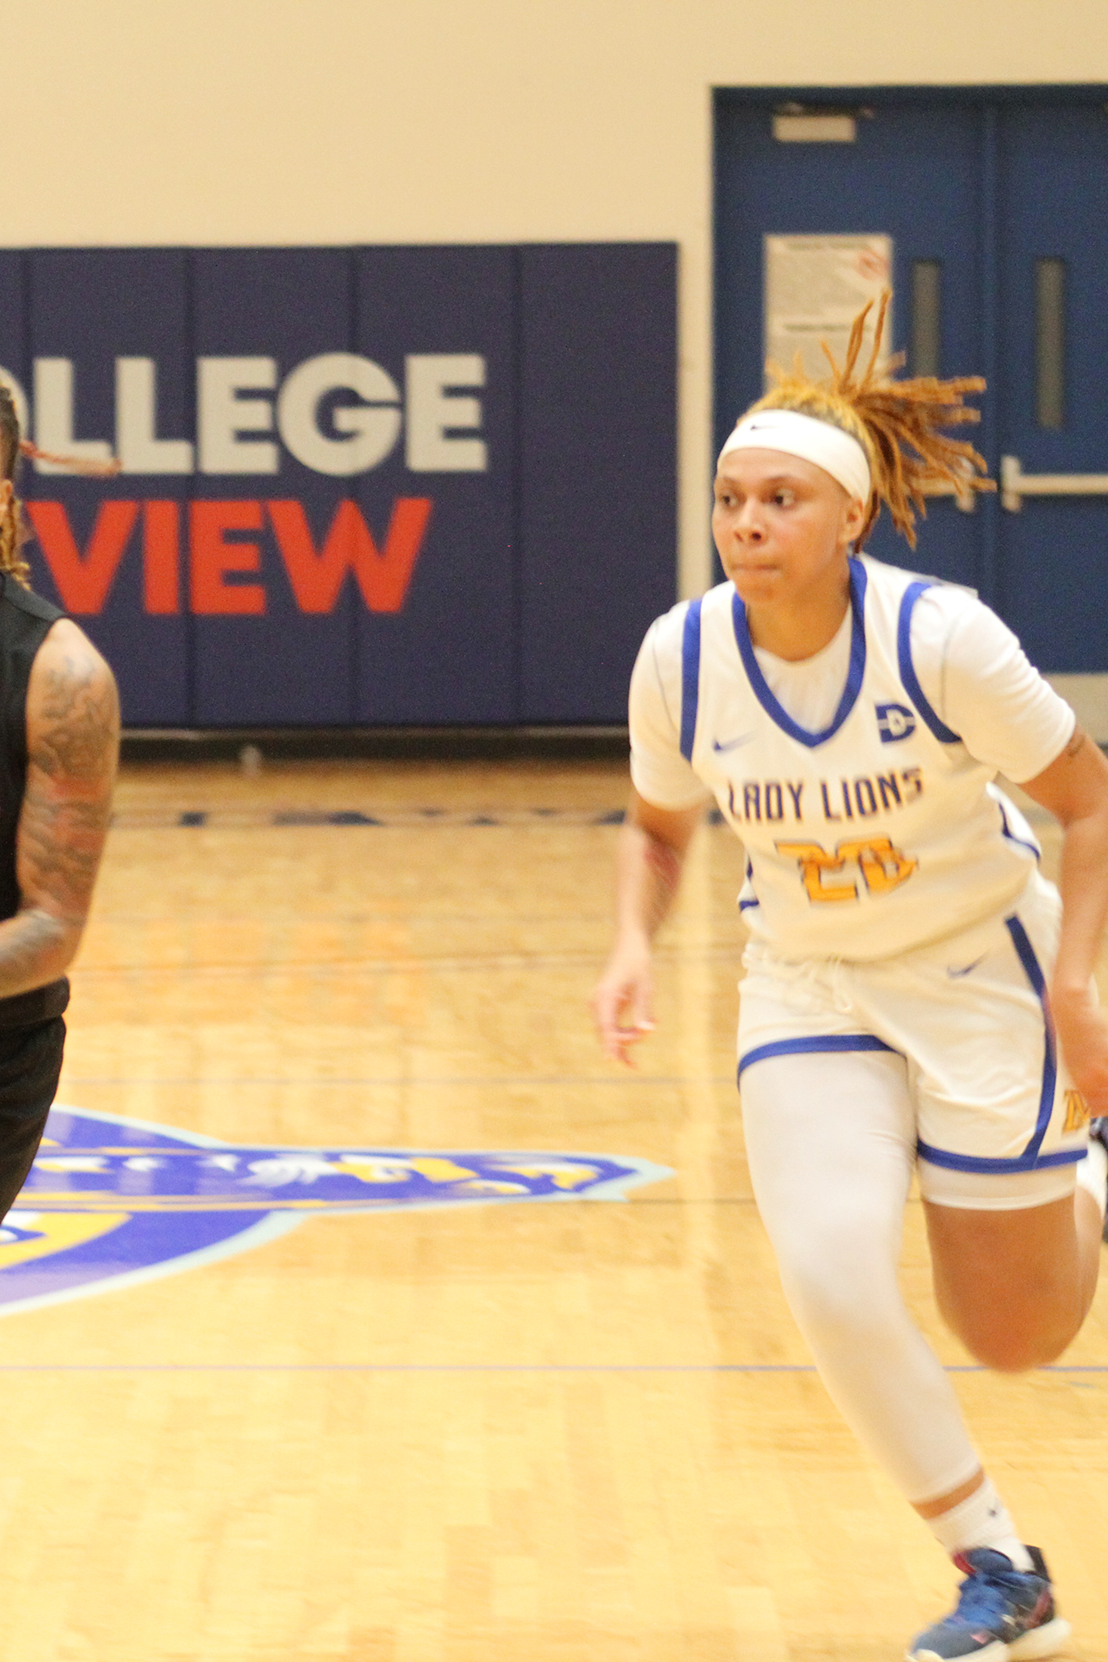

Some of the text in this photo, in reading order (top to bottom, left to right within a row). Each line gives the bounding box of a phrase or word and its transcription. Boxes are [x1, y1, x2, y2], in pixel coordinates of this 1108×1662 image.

[27, 496, 434, 615] VIEW
[728, 766, 923, 824] LADY LIONS
